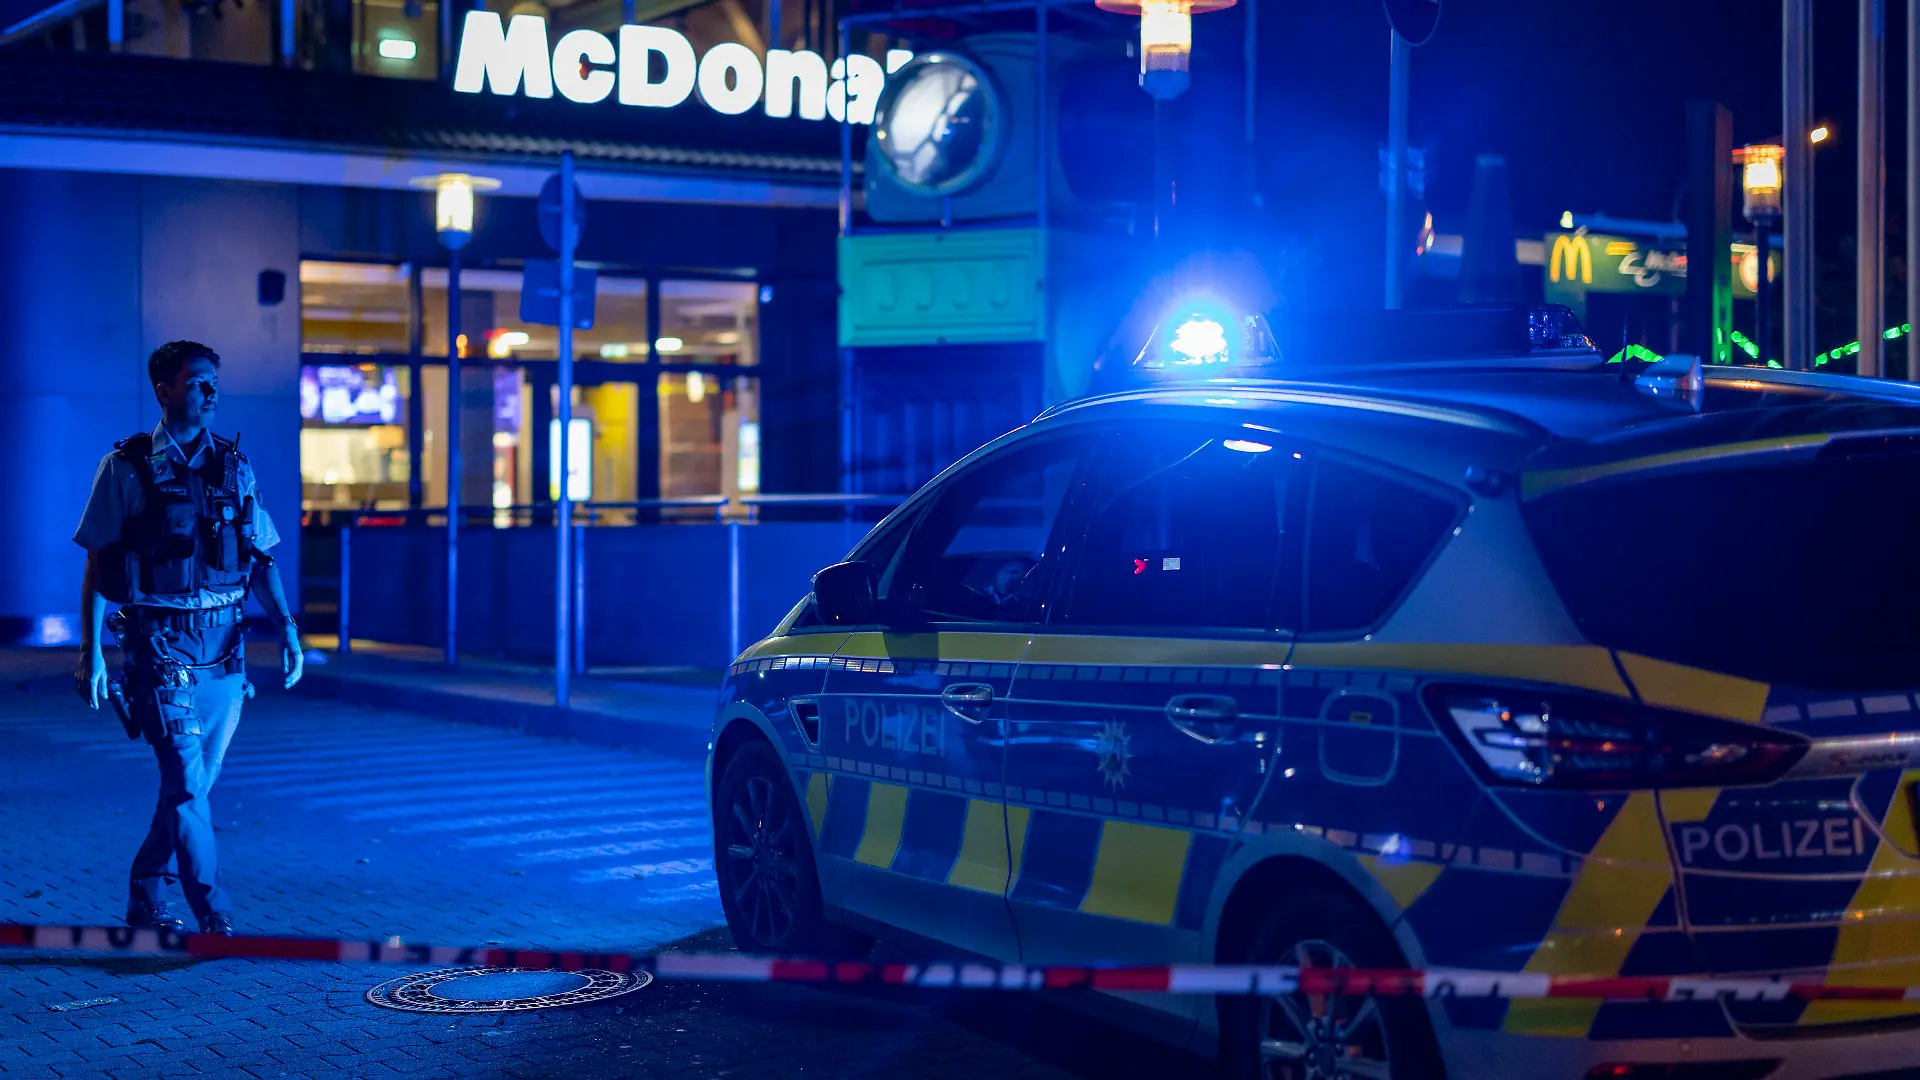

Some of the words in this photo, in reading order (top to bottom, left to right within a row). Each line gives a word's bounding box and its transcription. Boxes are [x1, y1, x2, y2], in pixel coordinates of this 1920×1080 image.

[454, 10, 913, 125] McDona
[846, 699, 945, 757] POLIZEI
[1682, 817, 1864, 863] POLIZEI
